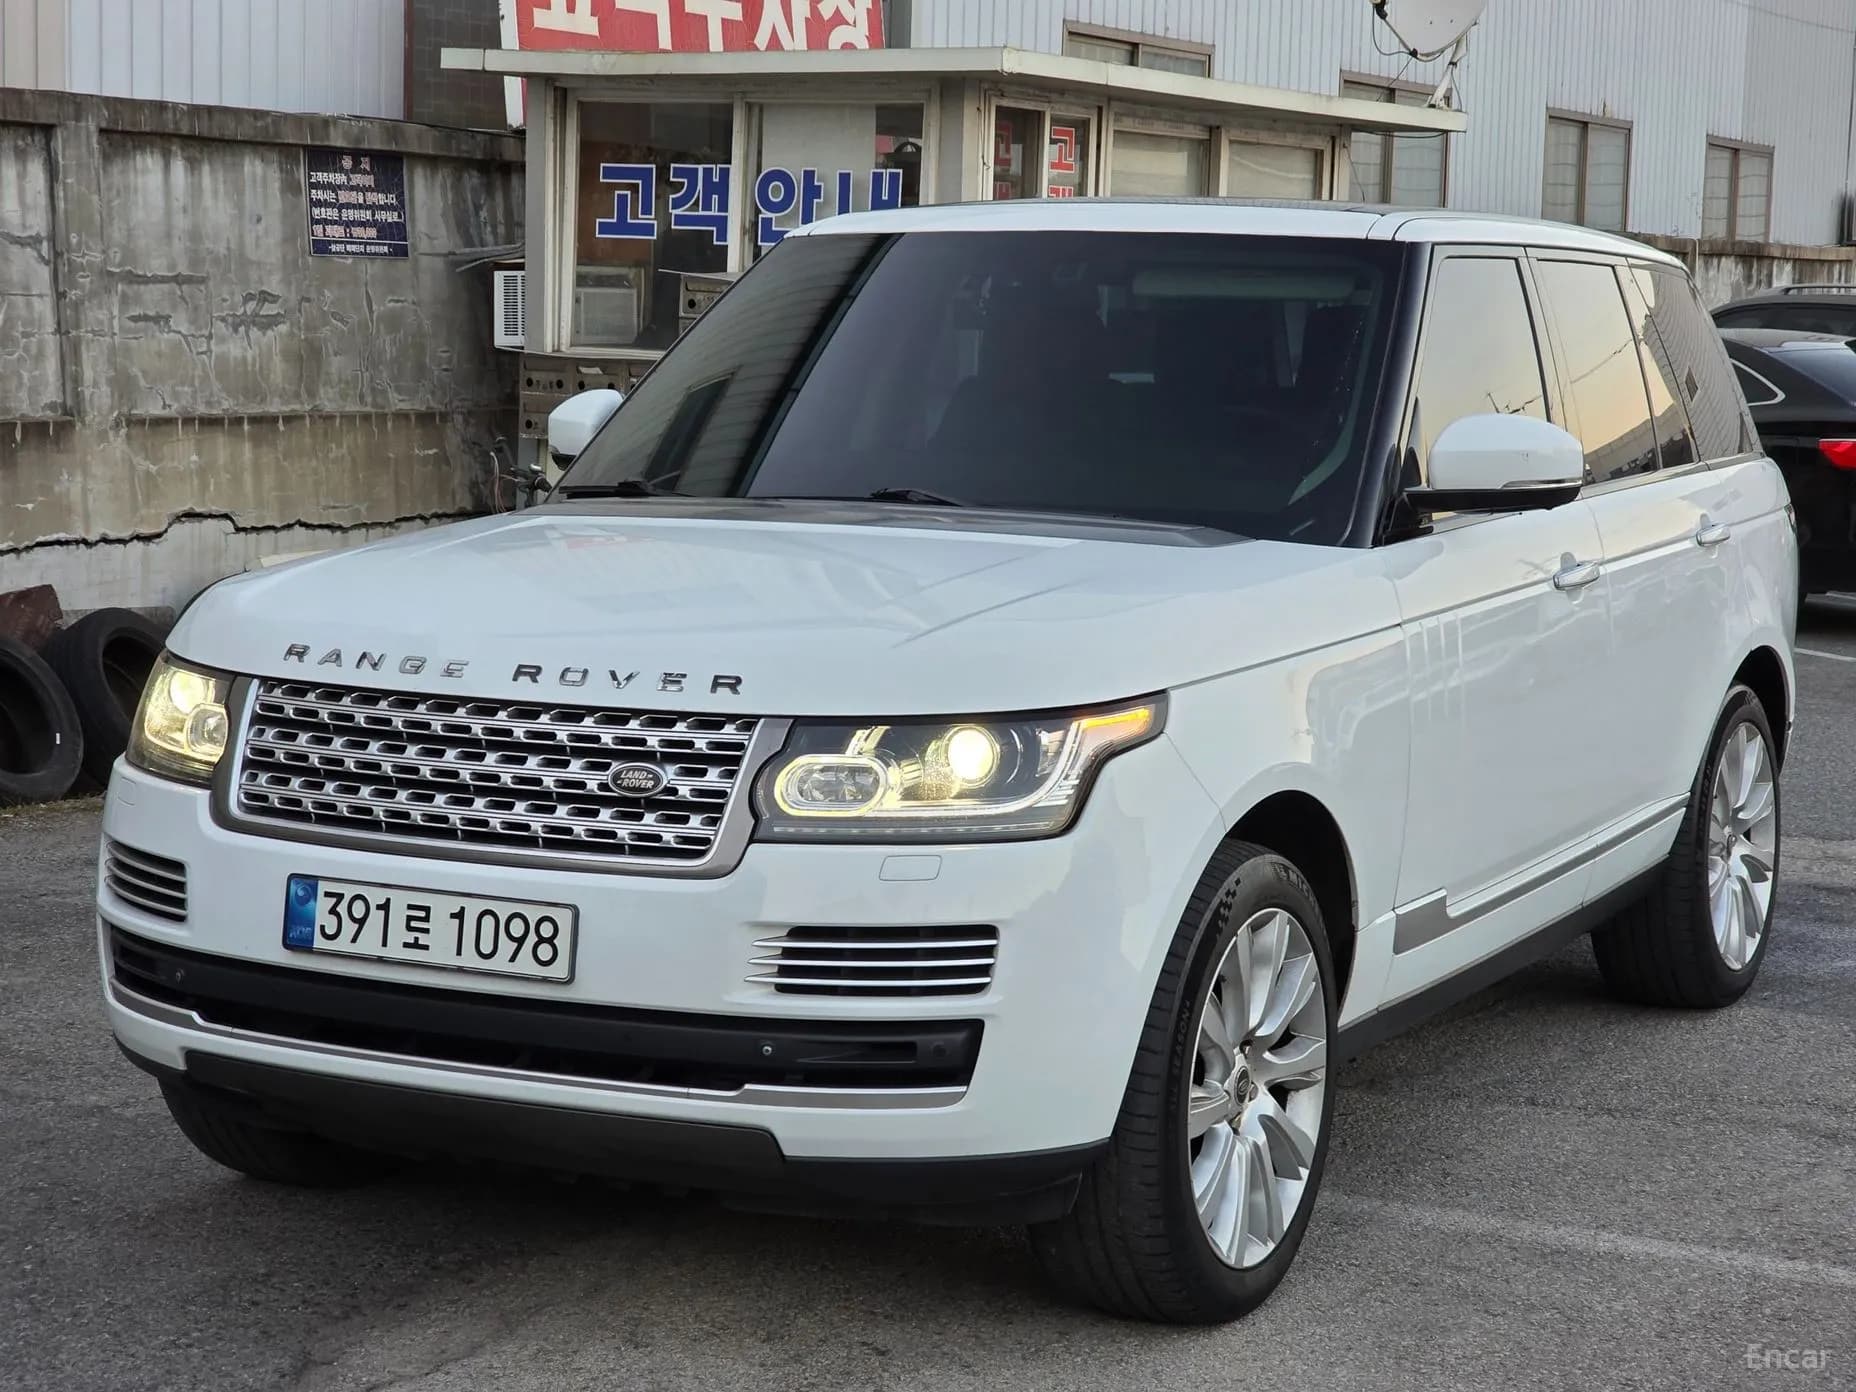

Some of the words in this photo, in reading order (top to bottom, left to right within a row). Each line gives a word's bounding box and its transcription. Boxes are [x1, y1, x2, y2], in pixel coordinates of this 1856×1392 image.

[310, 189, 337, 202] 주차시는
[283, 643, 469, 678] RANGE
[512, 663, 743, 695] ROVER
[449, 906, 560, 967] 1098
